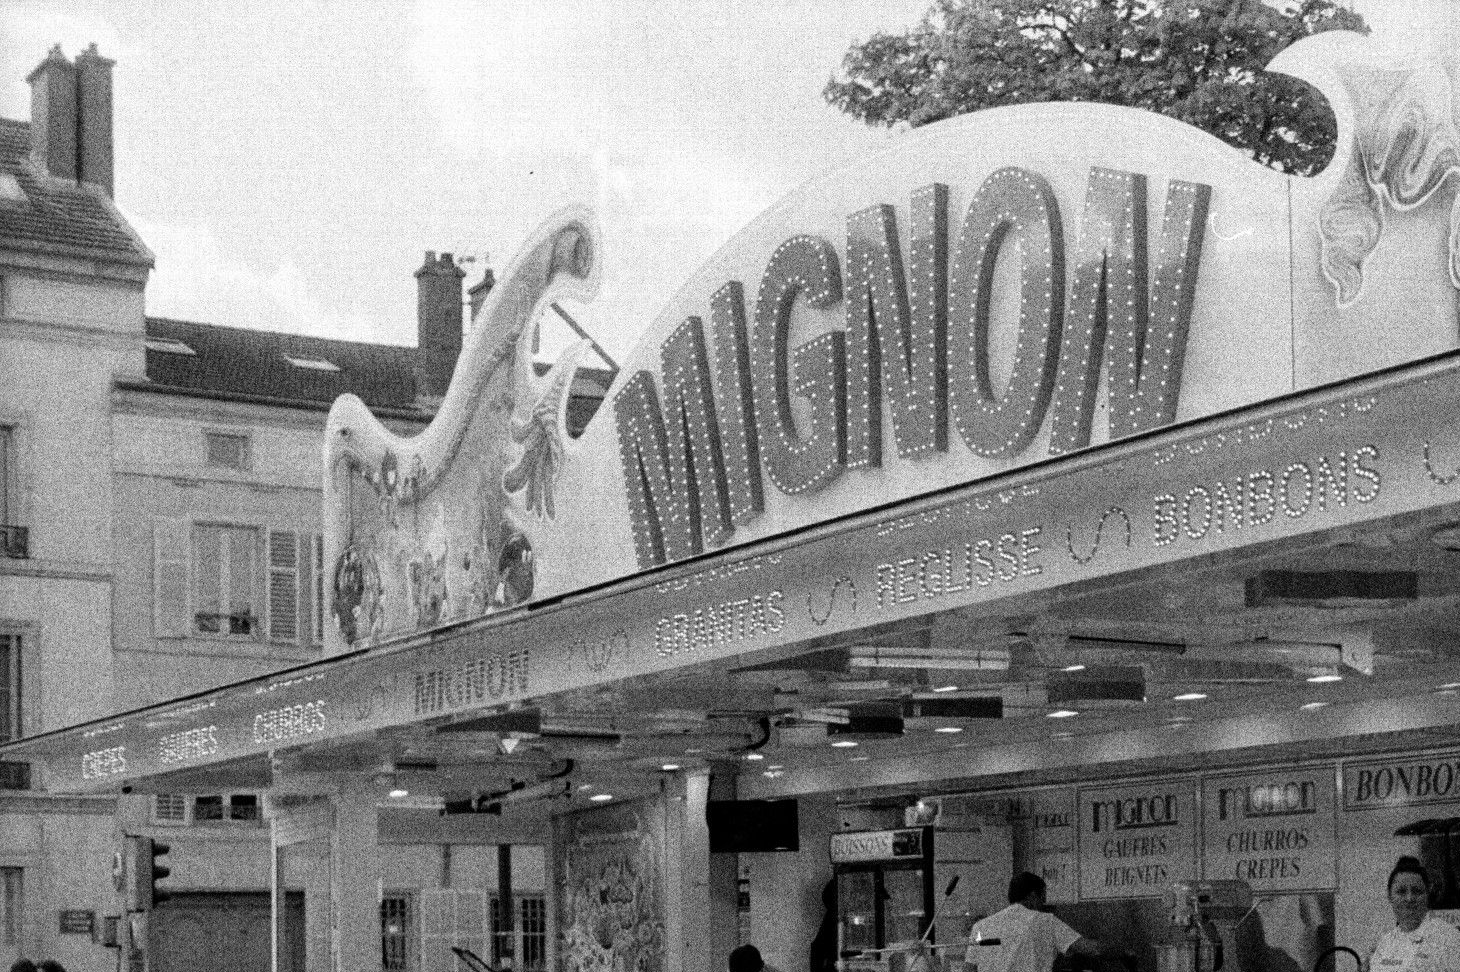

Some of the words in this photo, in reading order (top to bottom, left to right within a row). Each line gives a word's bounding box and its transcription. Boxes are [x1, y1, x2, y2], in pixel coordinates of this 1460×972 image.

[612, 165, 1212, 571] MIGNON
[1154, 446, 1381, 546] BONBONS
[876, 528, 1043, 608] REGLISSE
[655, 590, 785, 657] GRANITAS
[414, 649, 530, 715] MIGNON
[252, 699, 326, 744] CHURROS
[1103, 834, 1168, 859] GAUFRES
[1226, 828, 1309, 853] CHURROS
[1105, 864, 1168, 888] BEIGNETS
[1236, 857, 1301, 880] CREPES
